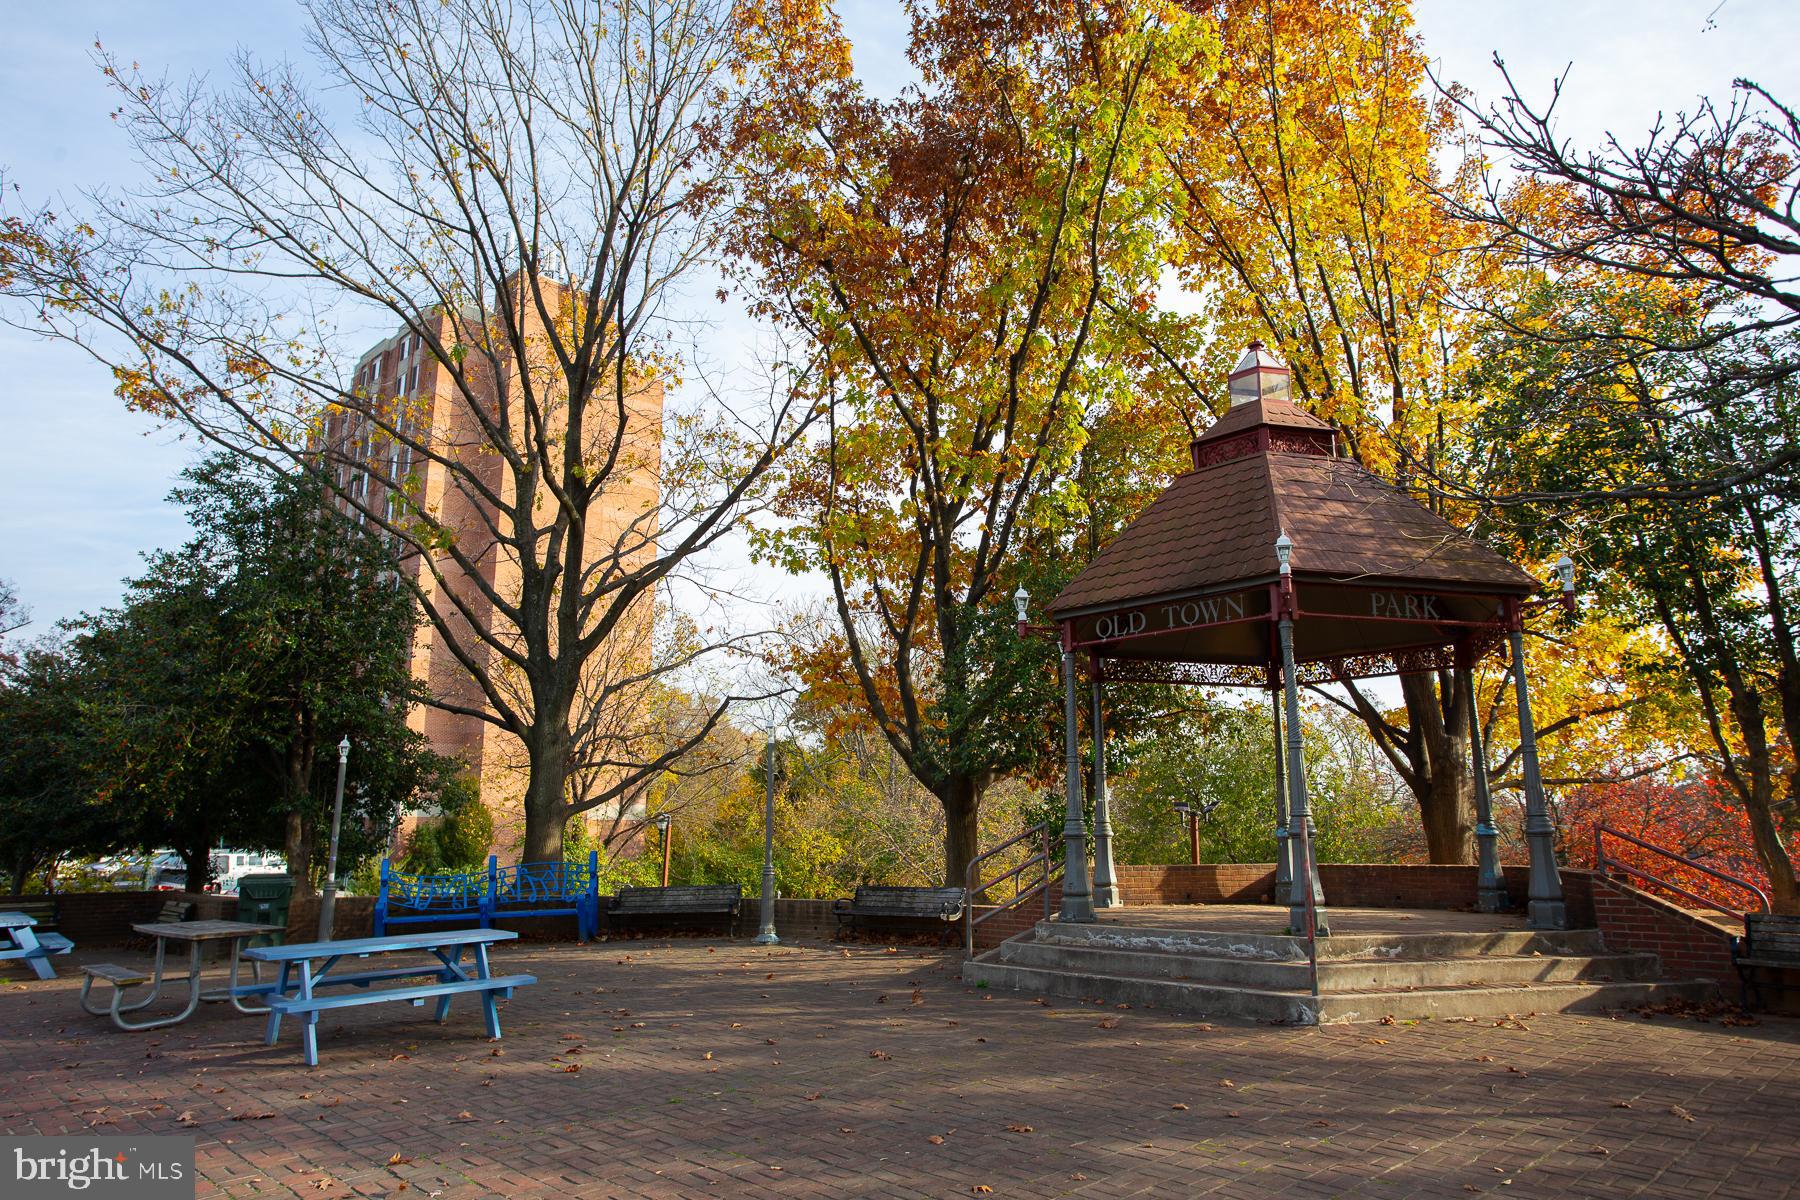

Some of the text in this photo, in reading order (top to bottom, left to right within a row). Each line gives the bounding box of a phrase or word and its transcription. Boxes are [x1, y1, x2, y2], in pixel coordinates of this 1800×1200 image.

[1095, 594, 1245, 639] OLD TOWN
[1370, 592, 1440, 619] PARK
